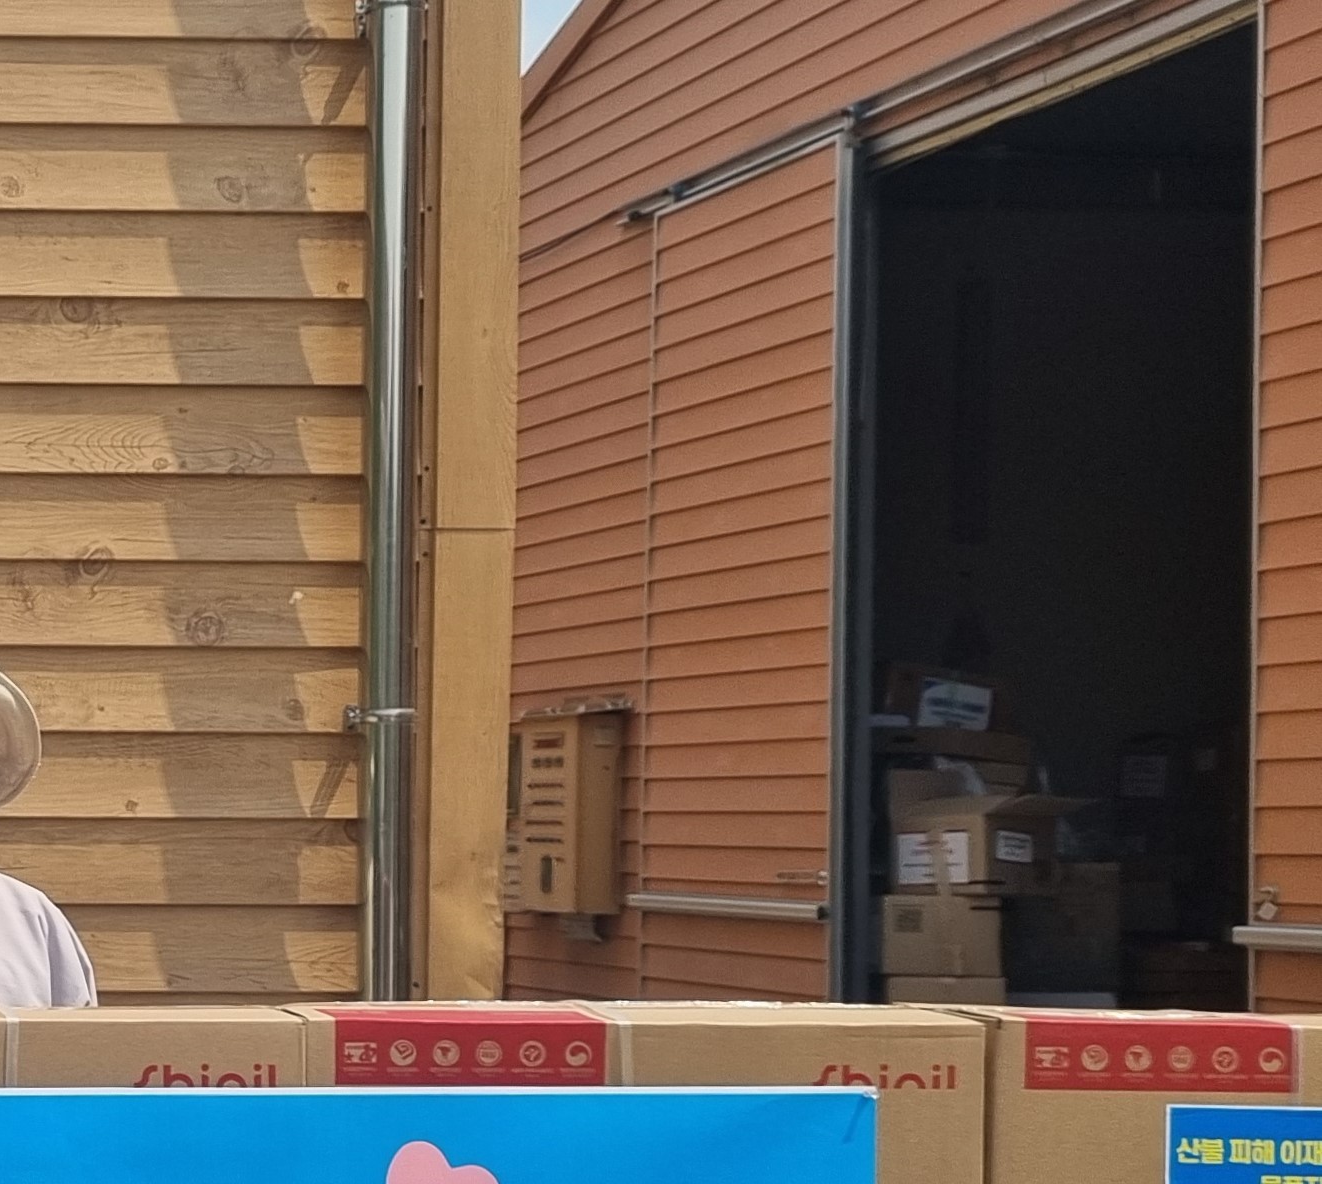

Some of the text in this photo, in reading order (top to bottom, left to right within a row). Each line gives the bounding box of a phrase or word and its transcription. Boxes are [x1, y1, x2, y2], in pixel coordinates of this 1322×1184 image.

[1176, 1138, 1322, 1165] 산불 피해 이재
